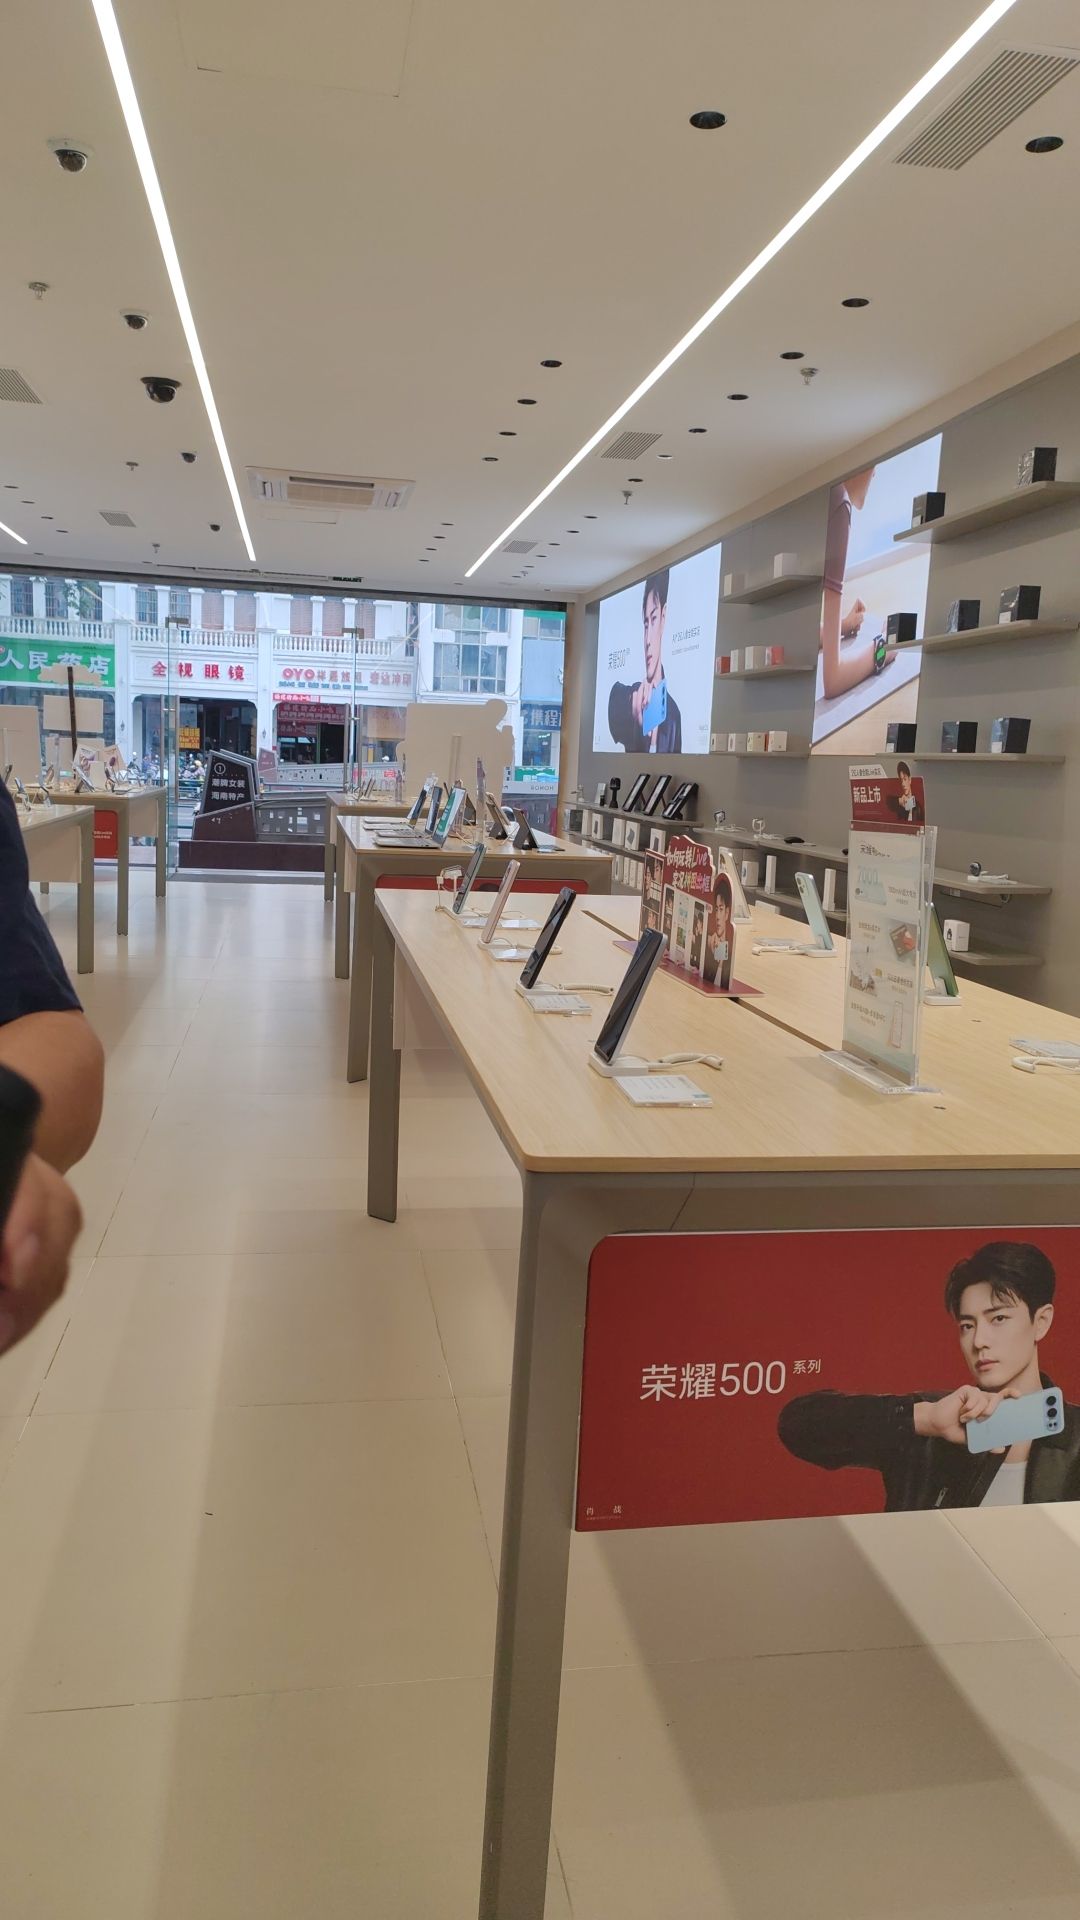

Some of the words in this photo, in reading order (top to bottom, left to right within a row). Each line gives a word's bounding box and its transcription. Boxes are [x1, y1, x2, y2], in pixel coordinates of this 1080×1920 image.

[0, 649, 111, 675] 人民药店
[152, 661, 245, 680] 全视眼镜
[212, 778, 245, 788] 潮牌女装
[212, 791, 245, 801] 海南特产
[853, 786, 881, 803] 新品上市
